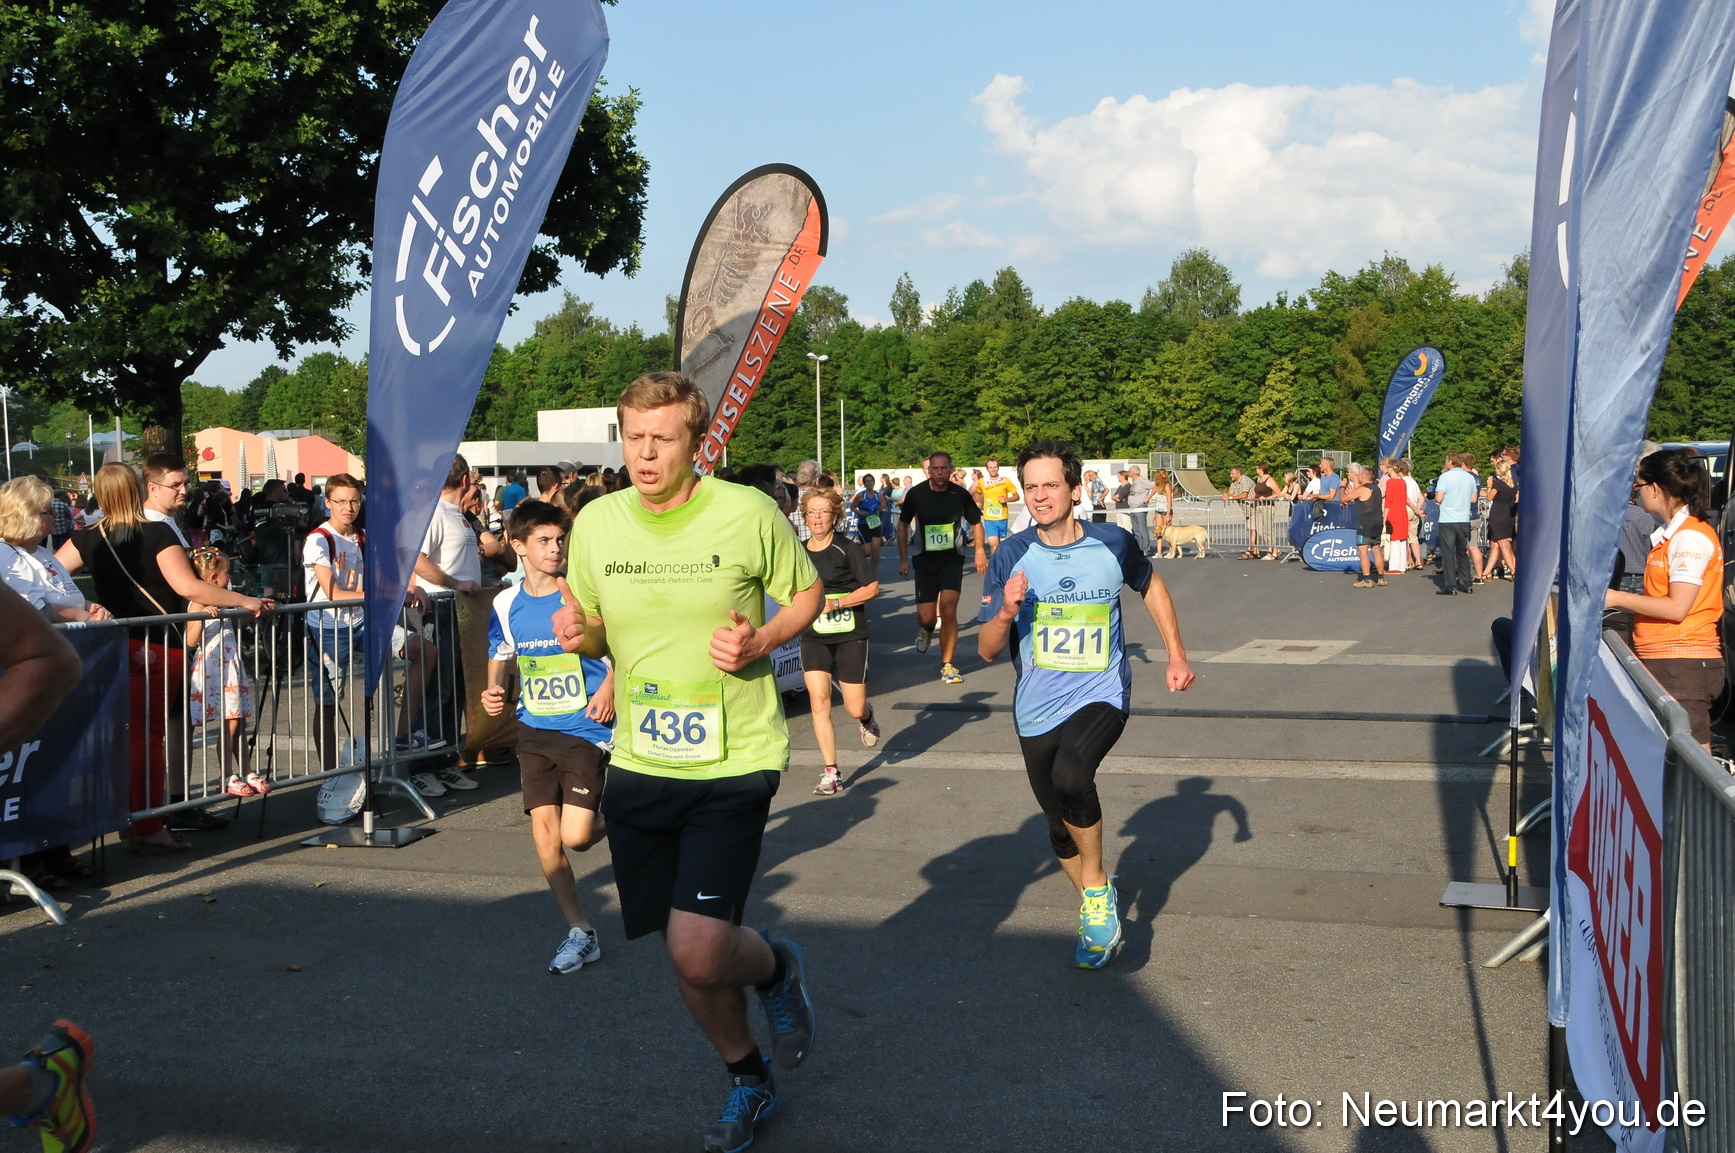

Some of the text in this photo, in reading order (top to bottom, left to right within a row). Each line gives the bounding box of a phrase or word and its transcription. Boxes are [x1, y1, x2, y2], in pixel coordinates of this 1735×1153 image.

[423, 14, 549, 307] Fischer
[467, 63, 565, 298] AUTOMOBILE
[930, 533, 948, 544] 101
[1322, 546, 1357, 557] Fisch
[605, 561, 713, 576] globalconcepts
[1037, 627, 1103, 654] 1211
[525, 674, 581, 700] 1260
[639, 709, 706, 745] 436
[0, 797, 20, 822] E
